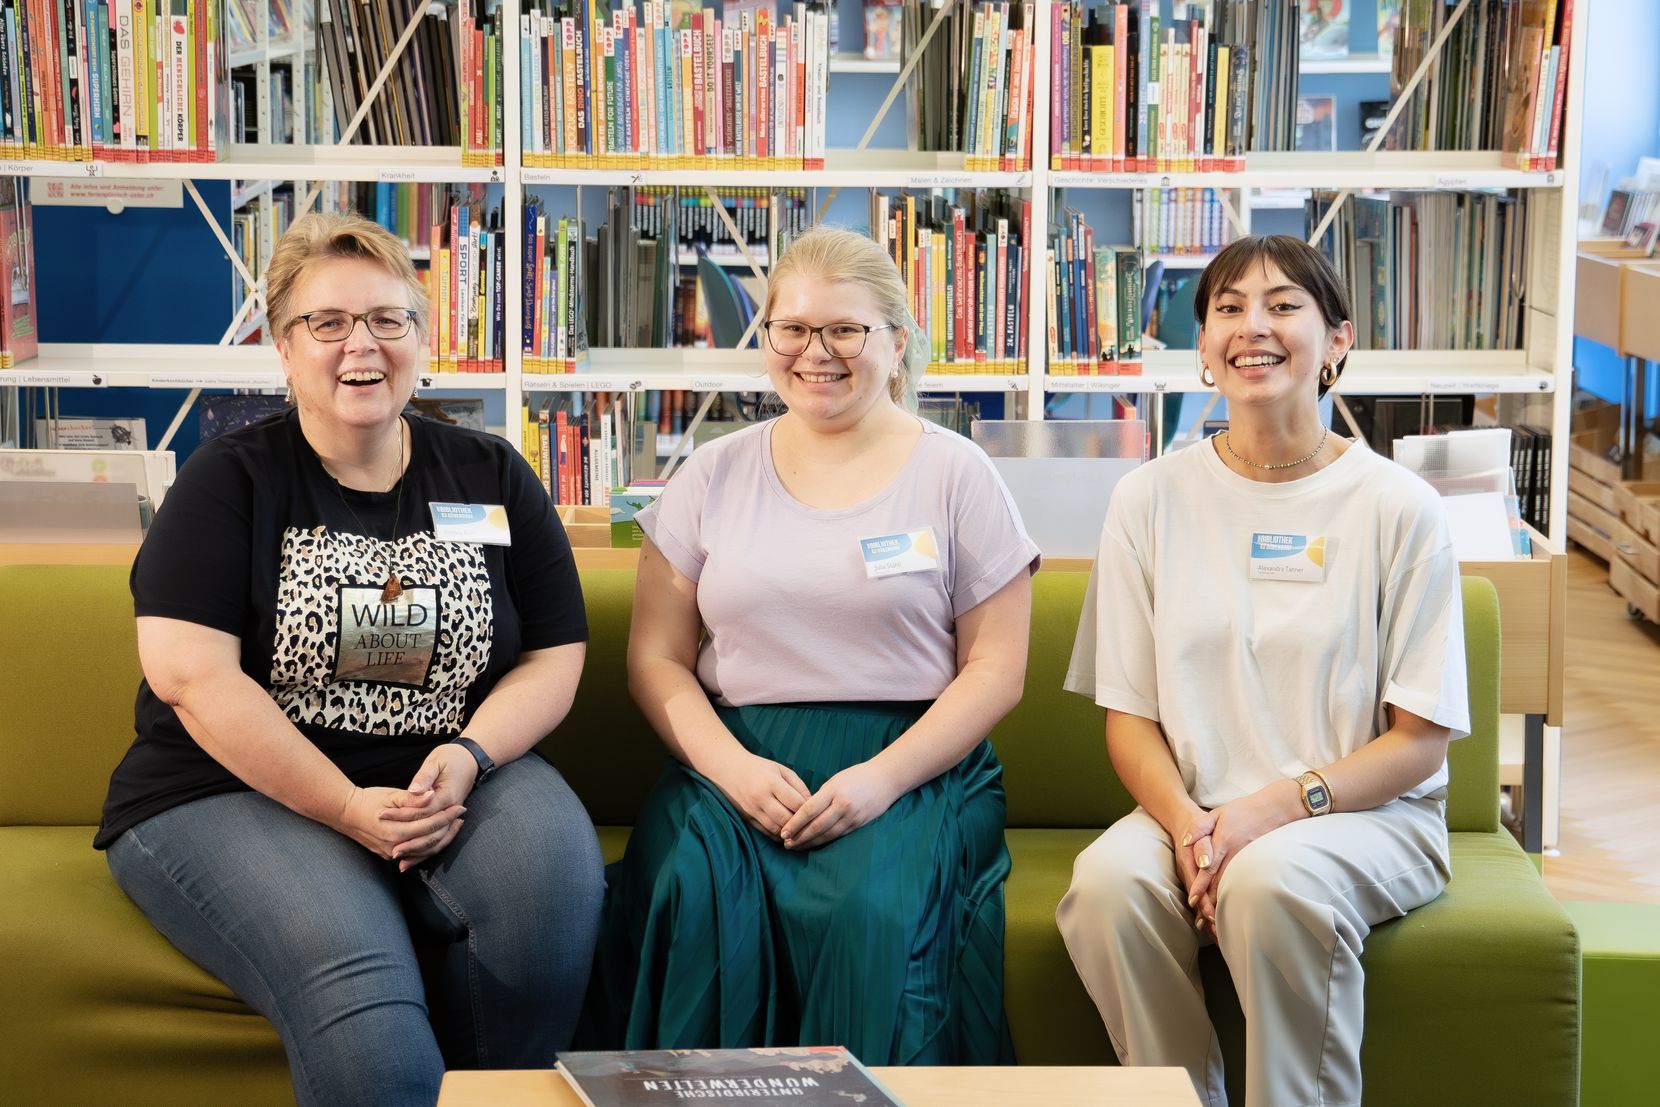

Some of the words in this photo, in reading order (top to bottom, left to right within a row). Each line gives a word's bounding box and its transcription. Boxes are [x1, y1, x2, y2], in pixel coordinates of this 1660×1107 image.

[119, 16, 129, 50] DAS
[175, 41, 183, 55] DER
[576, 30, 584, 85] BASTELBUCH
[693, 29, 703, 85] BASTELBUCH
[759, 35, 768, 88] BASTELBUCH
[121, 56, 131, 117] GEHIRN
[566, 60, 575, 105] BASTELN
[707, 81, 714, 92] DO
[92, 73, 100, 118] SUPERHIRN
[577, 88, 585, 109] DINO
[8, 164, 33, 172] Körper
[113, 184, 145, 192] Anmeldung
[955, 230, 963, 306] Weihnachts-Bastelbuch
[1090, 382, 1121, 390] Wikinger
[351, 603, 428, 627] WILD
[354, 632, 422, 649] ABOUT
[366, 651, 406, 667] LIFE
[643, 1077, 820, 1092] WUNDERWELTEN
[674, 1088, 804, 1099] UNTERIRDISCHE
